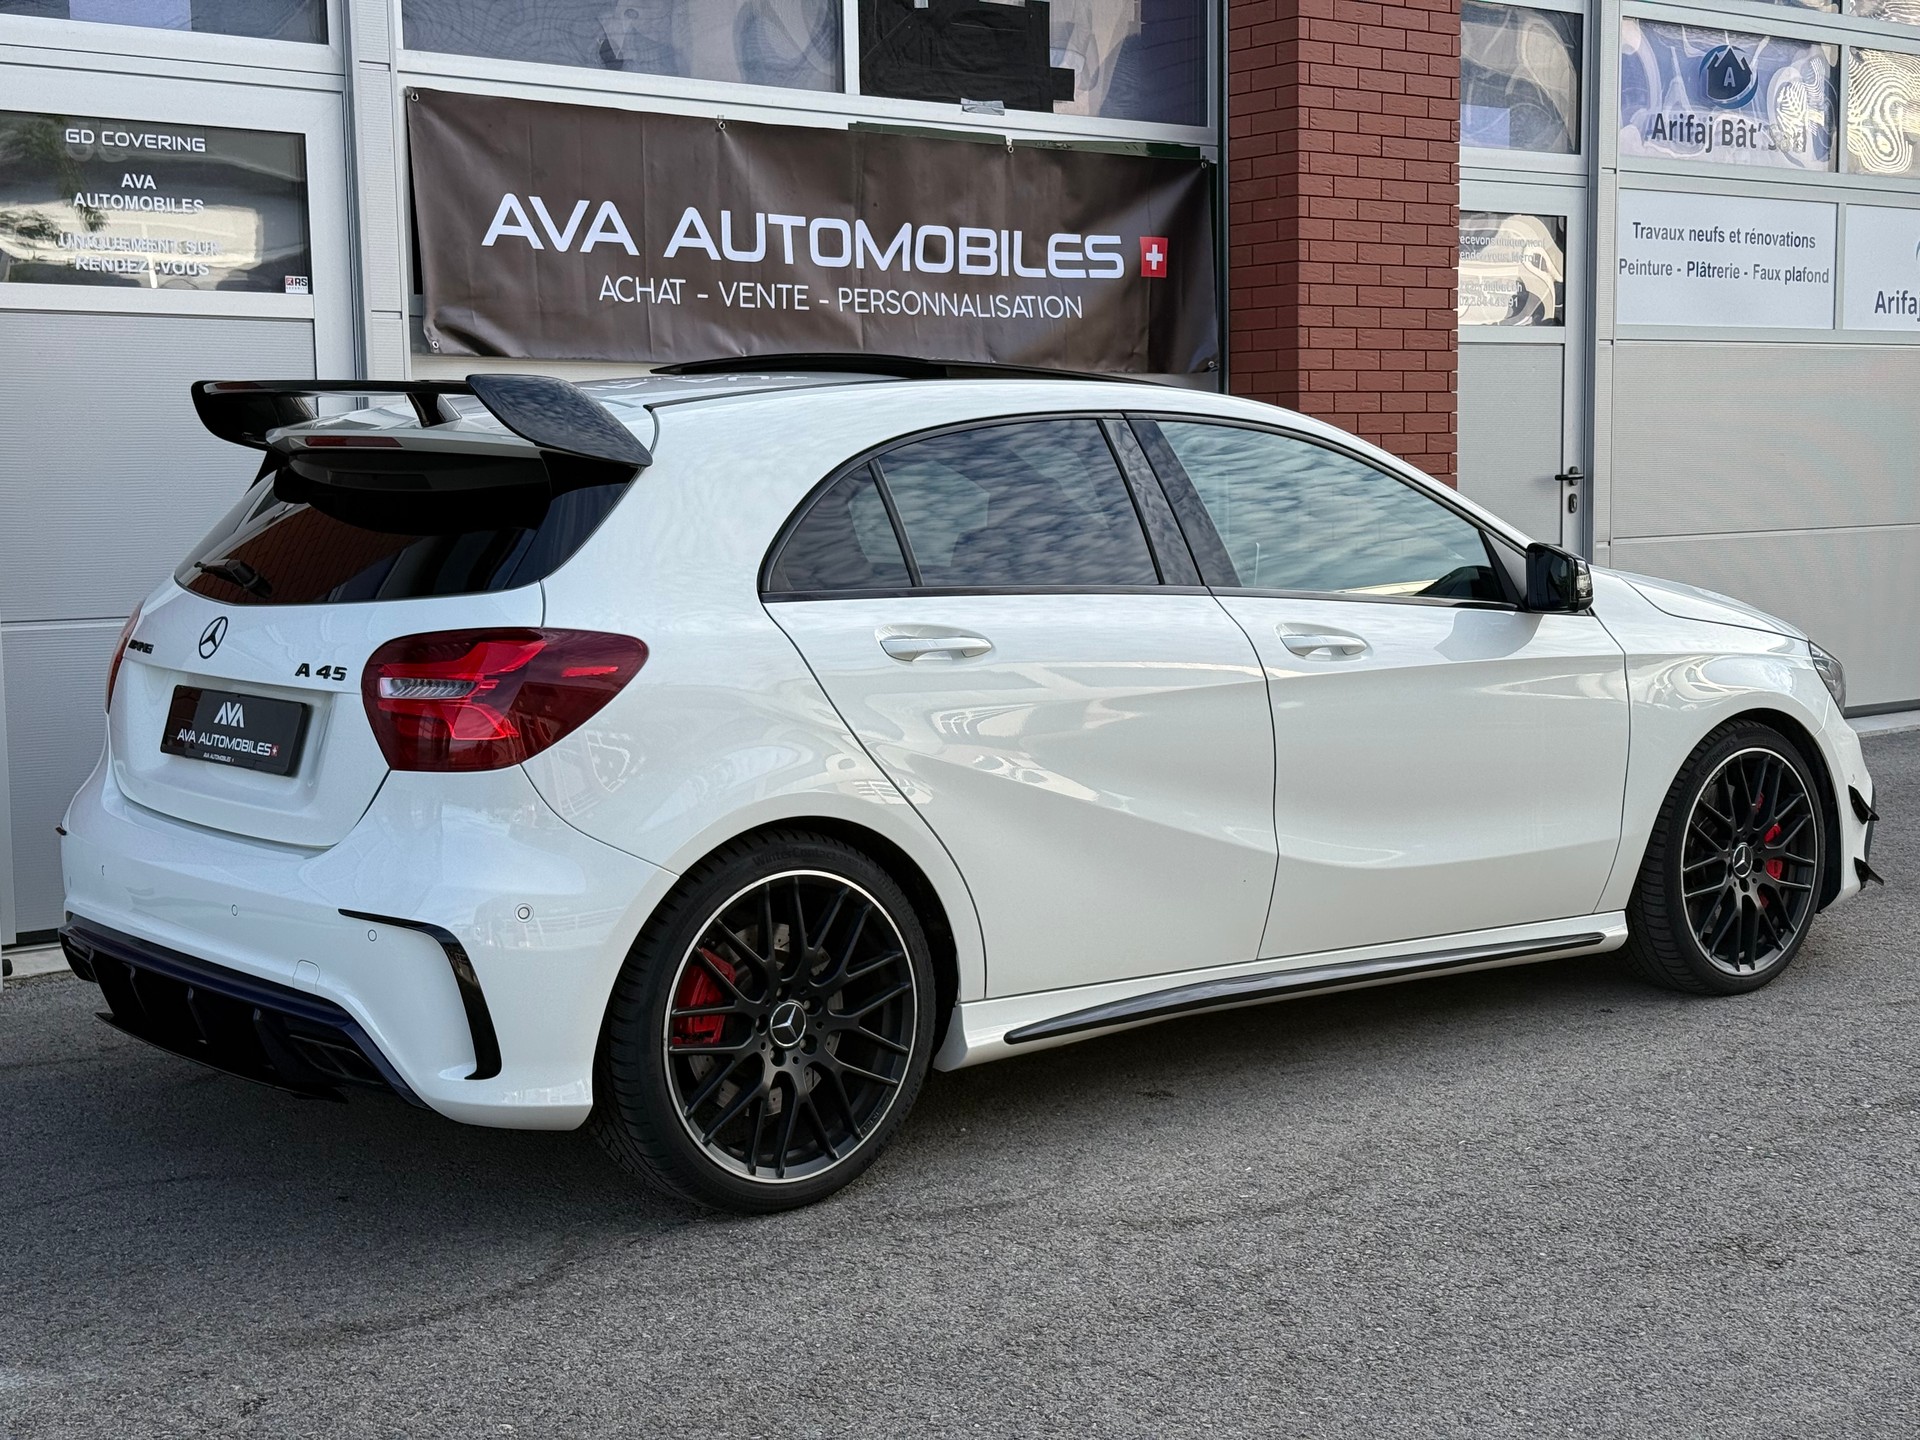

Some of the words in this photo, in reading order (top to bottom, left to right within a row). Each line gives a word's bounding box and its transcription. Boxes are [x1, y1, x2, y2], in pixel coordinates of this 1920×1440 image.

[65, 128, 95, 145] GD
[101, 130, 206, 153] COVERING
[1651, 112, 1713, 153] Arifaj
[121, 173, 157, 190] AVA
[73, 192, 205, 214] AUTOMOBILES
[59, 232, 180, 253] UNIQUEMENT
[186, 240, 221, 256] SUR
[482, 192, 640, 257] AVA
[663, 205, 1125, 280] AUTOMOBILES
[1459, 235, 1496, 246] ecevons
[1632, 221, 1685, 242] Travaux
[1689, 226, 1726, 244] neufs
[1729, 228, 1742, 244] et
[1744, 228, 1817, 249] rénovations
[294, 277, 308, 287] RS
[1618, 257, 1673, 277] Peinture
[1686, 259, 1740, 279] Plâtrerie
[1753, 264, 1781, 282] Faux
[1784, 266, 1829, 286] plafond
[599, 275, 686, 306] ACHAT
[718, 280, 810, 311] VENTE
[839, 289, 1083, 320] PERSONNALISATION
[295, 662, 311, 678] A
[315, 665, 348, 682] 45
[213, 701, 245, 729] AVA
[177, 728, 196, 744] AVA
[198, 732, 272, 757] AUTOMOBILES
